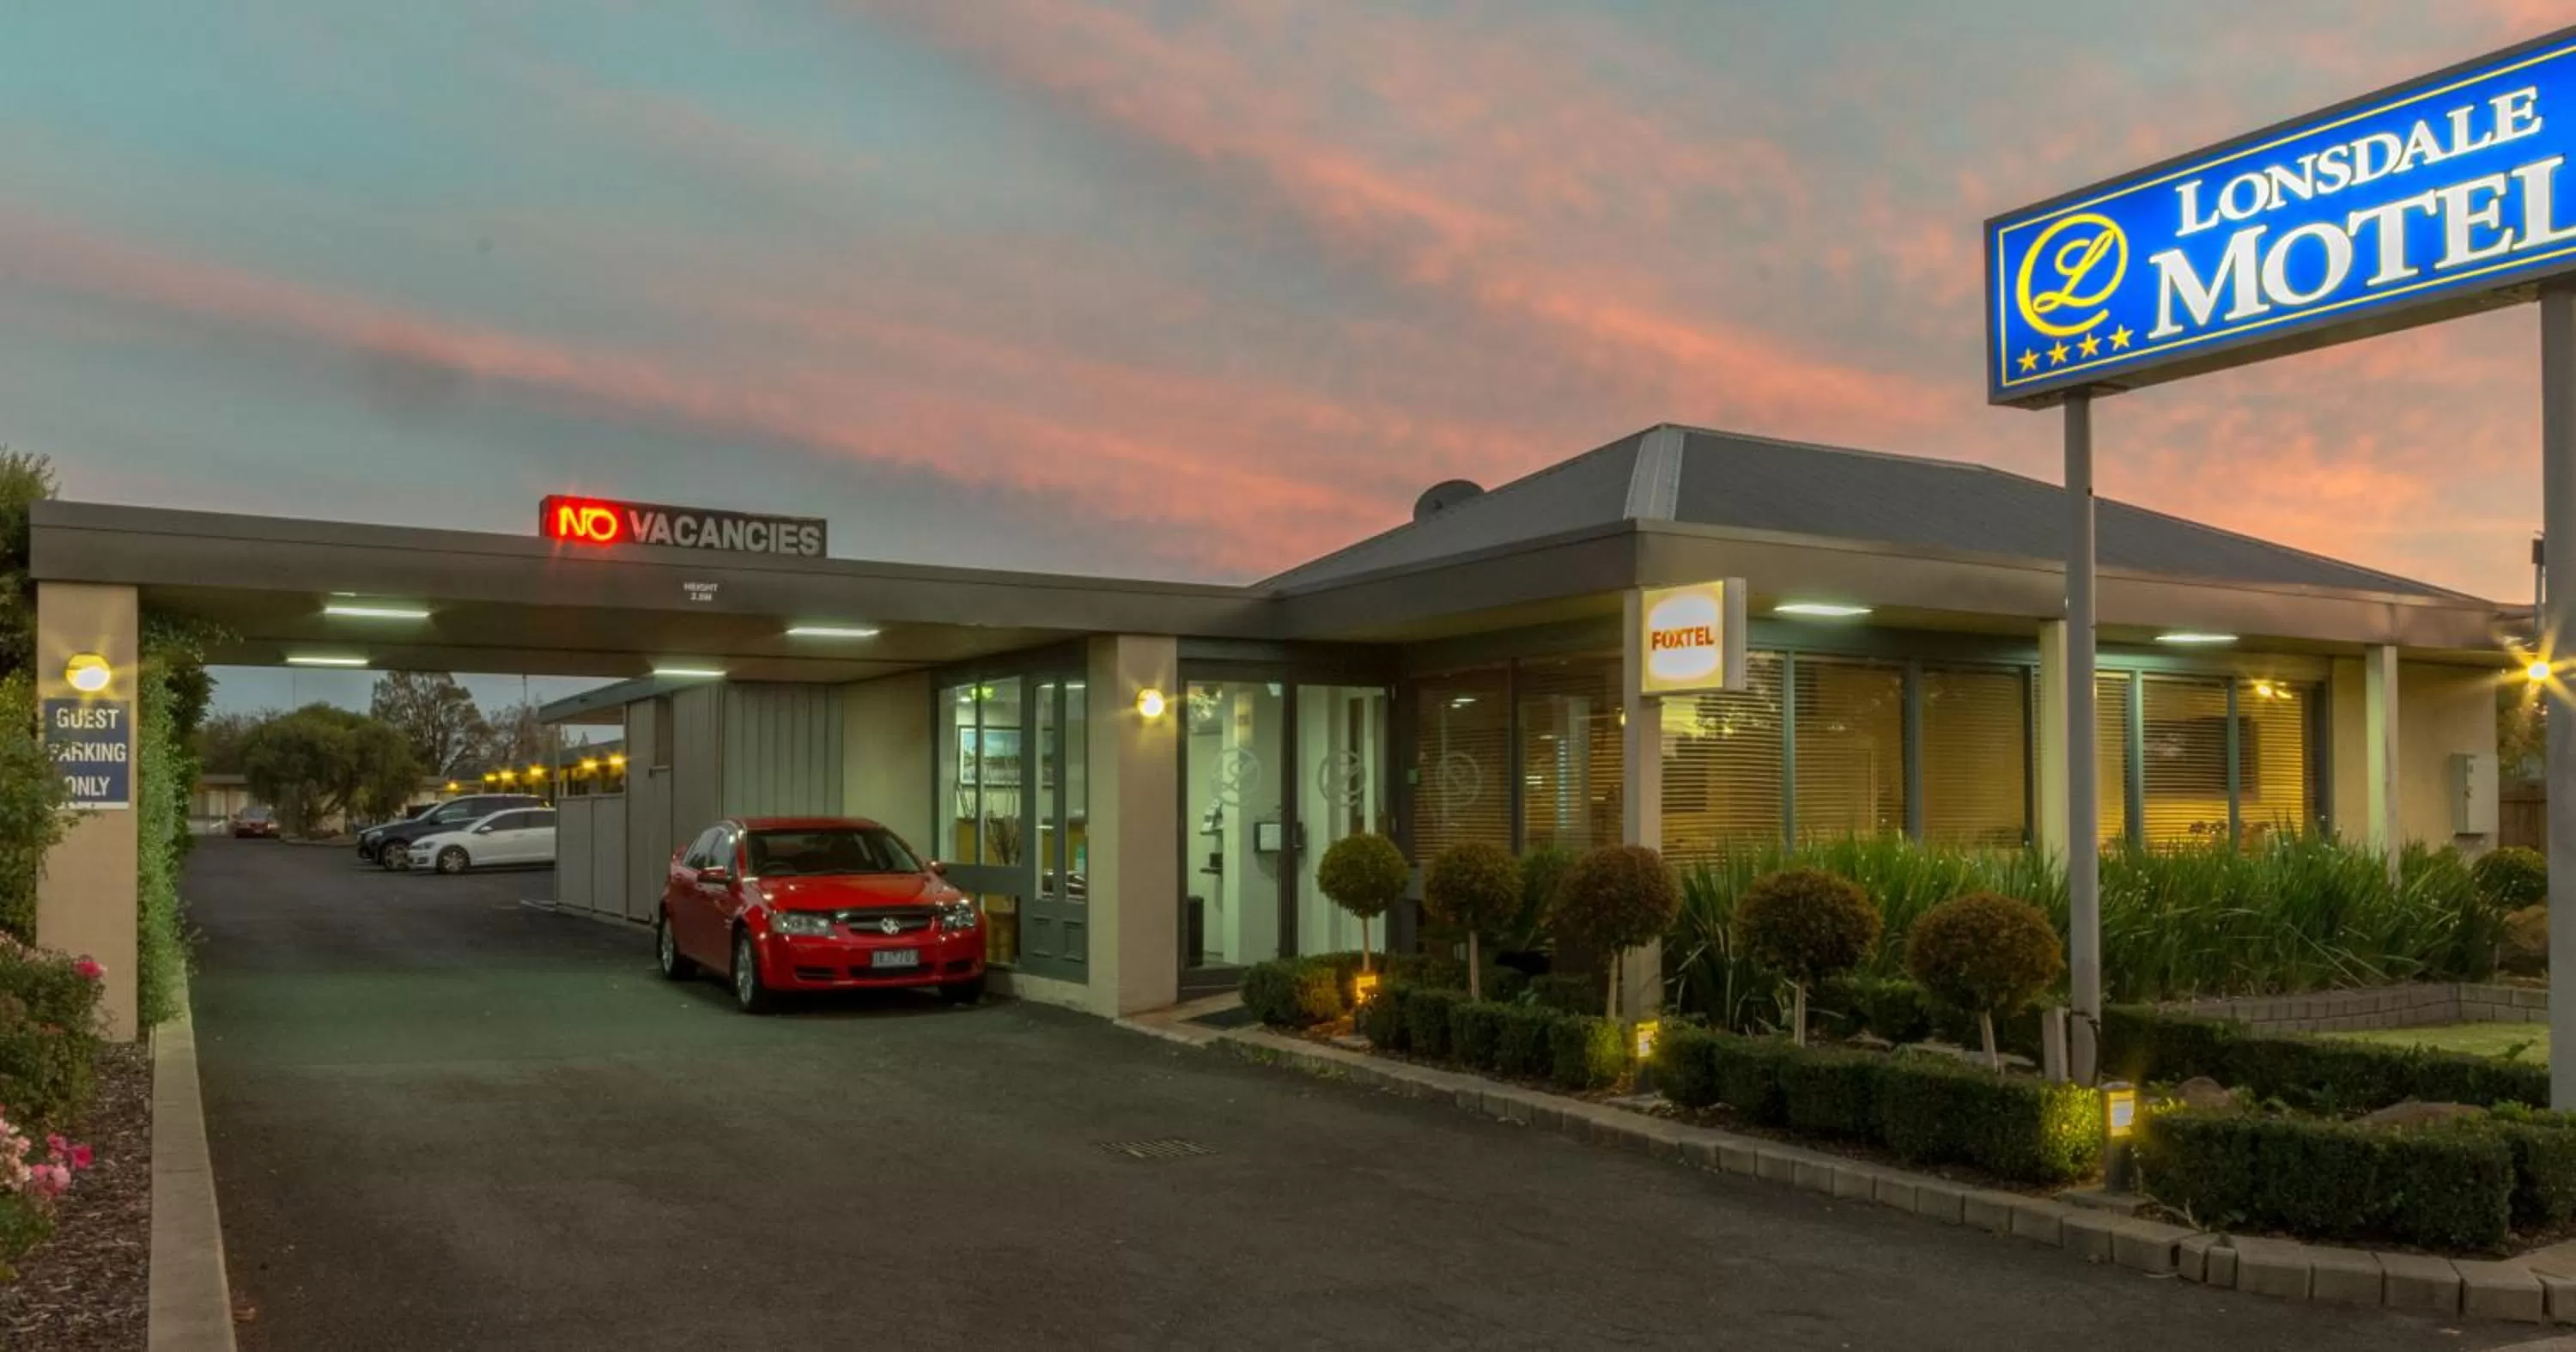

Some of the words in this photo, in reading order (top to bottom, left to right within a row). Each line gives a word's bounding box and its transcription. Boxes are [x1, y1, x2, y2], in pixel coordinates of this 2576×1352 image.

[2176, 87, 2543, 236] LONSDALE
[2148, 155, 2576, 339] MOTEL
[558, 506, 617, 541] NO
[629, 510, 821, 555] VACANCIES
[1651, 625, 1715, 650] FOXTEL
[56, 707, 119, 729] GUEST
